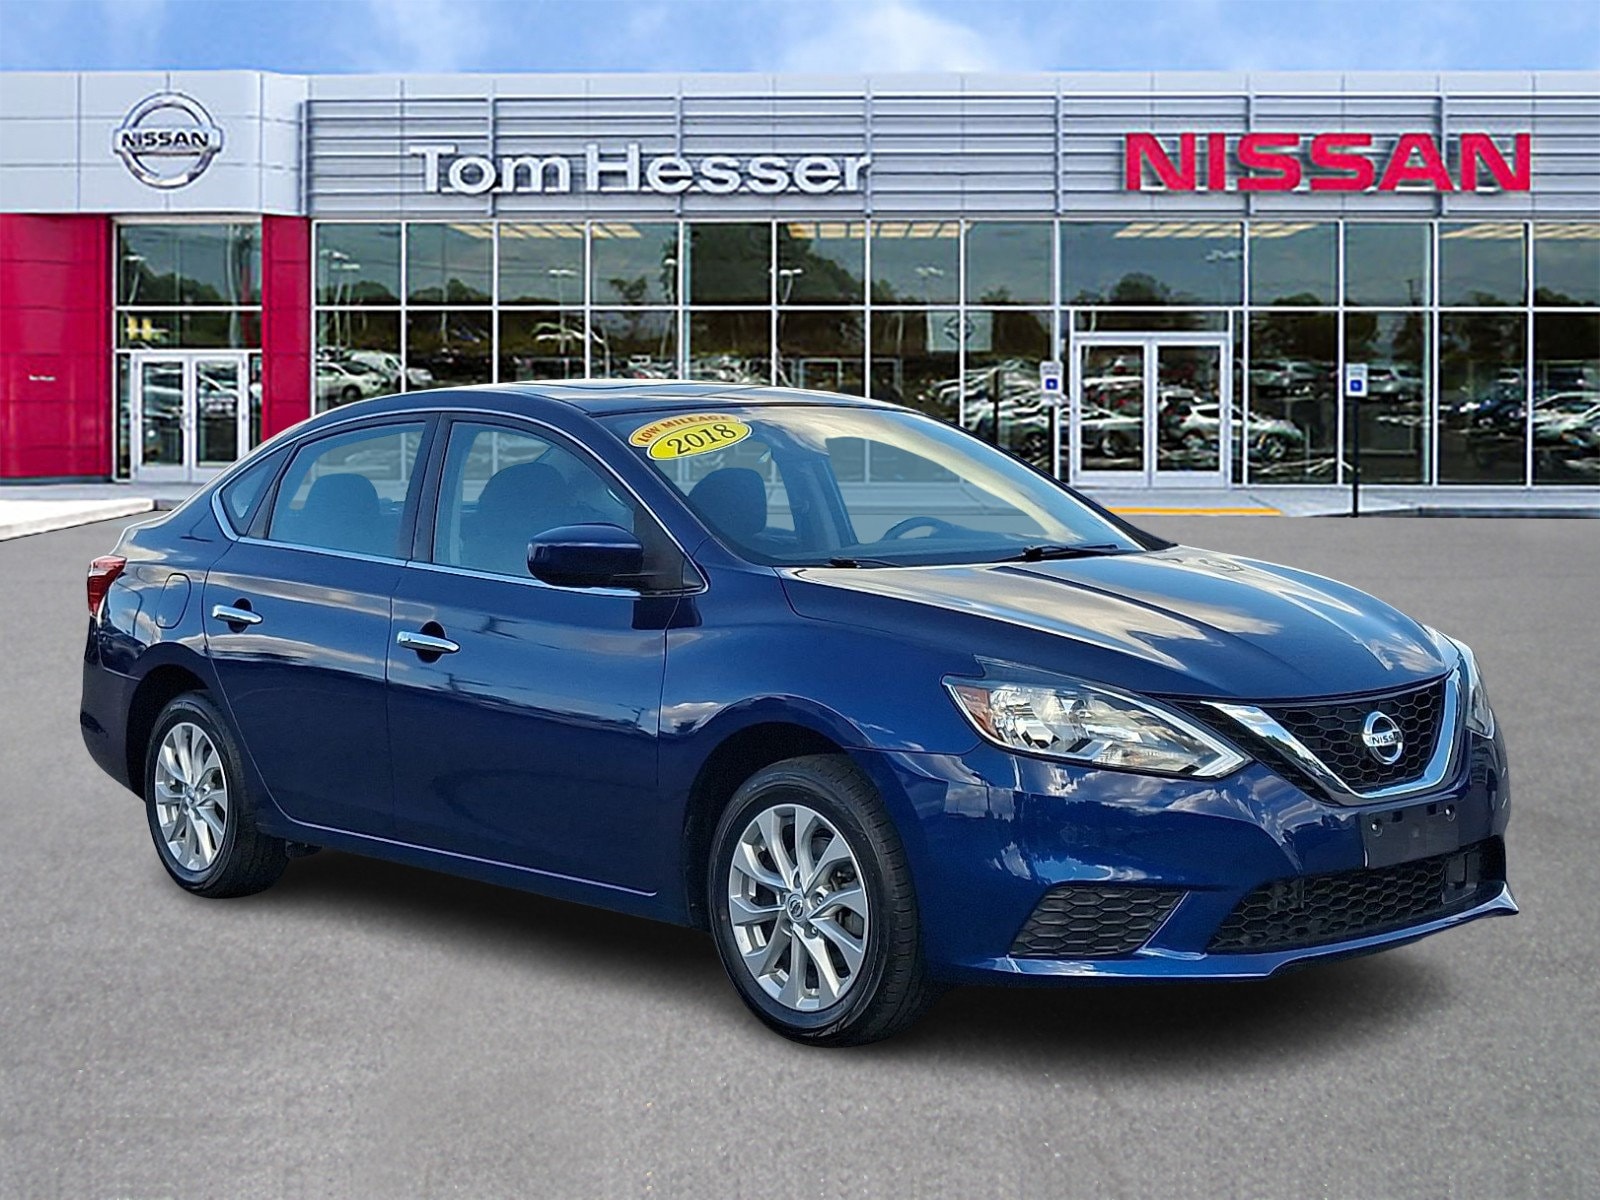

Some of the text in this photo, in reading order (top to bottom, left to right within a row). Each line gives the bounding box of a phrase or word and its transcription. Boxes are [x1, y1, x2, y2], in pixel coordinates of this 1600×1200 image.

[121, 131, 209, 147] NISSAN
[408, 142, 871, 195] Tom Hesser
[1125, 131, 1531, 192] NISSAN
[637, 425, 662, 443] LOW
[666, 423, 737, 455] 2018
[1371, 733, 1400, 745] NISS
